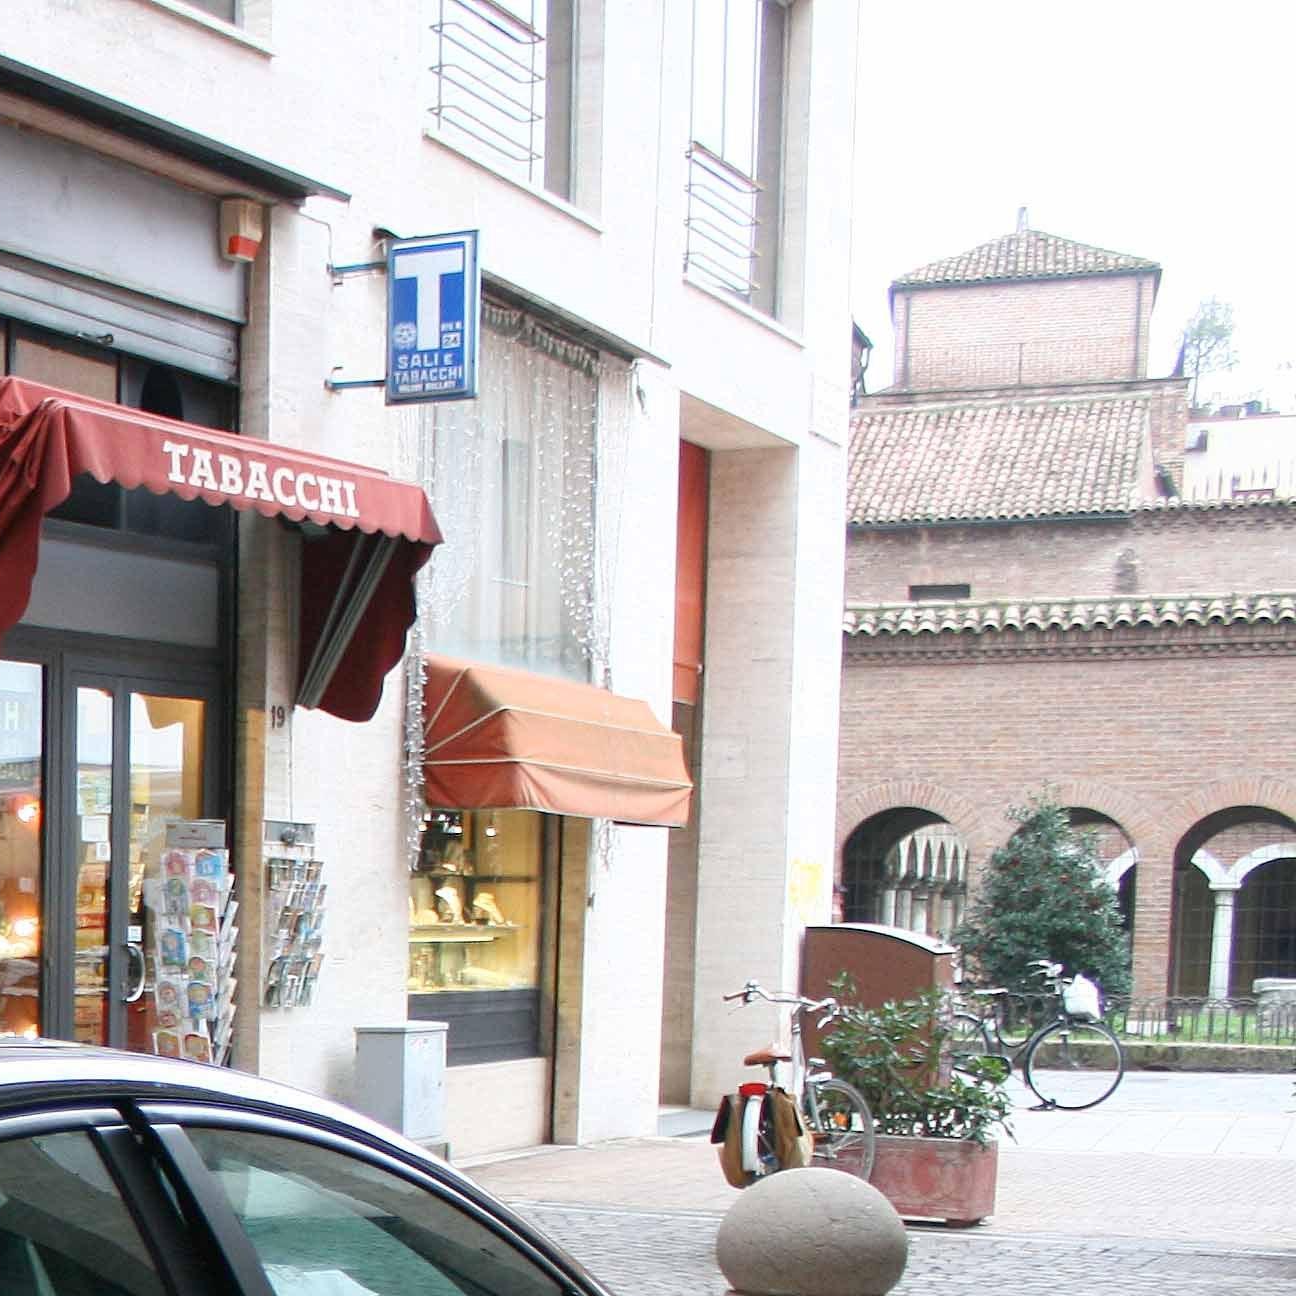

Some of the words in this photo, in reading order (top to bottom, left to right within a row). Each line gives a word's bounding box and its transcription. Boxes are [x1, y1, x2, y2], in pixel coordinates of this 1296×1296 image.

[397, 353, 438, 370] SALI
[393, 366, 463, 386] TABACCHI
[162, 440, 360, 517] TABACCHI
[271, 704, 286, 729] 19
